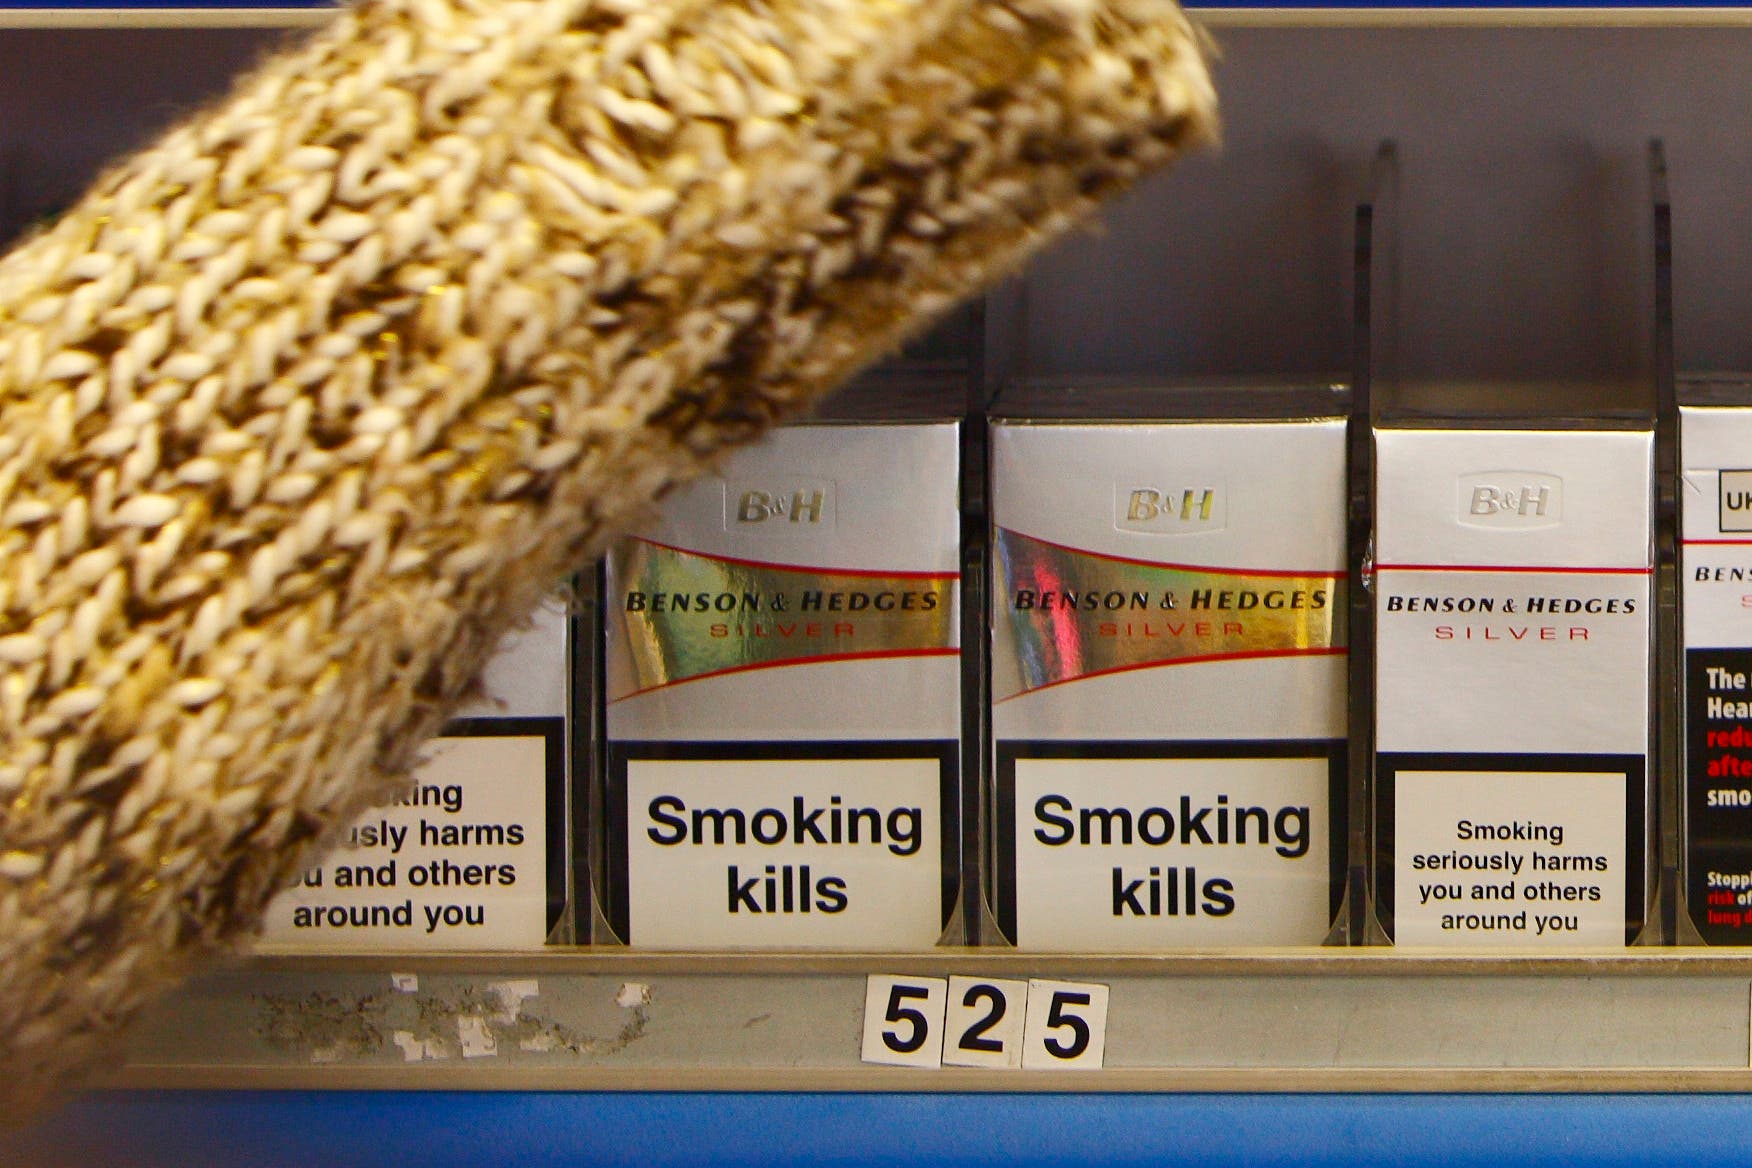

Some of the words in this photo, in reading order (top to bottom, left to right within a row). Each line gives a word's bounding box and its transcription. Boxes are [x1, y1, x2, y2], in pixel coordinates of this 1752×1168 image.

[1470, 486, 1550, 517] B&H
[626, 591, 760, 613] BENSON
[771, 592, 787, 612] &
[801, 591, 938, 612] HEDGES
[1015, 589, 1149, 611] BENSON
[1161, 590, 1176, 610] &
[1190, 589, 1327, 610] HEDGES
[1387, 596, 1495, 613] BENSON
[1502, 598, 1518, 614] &
[1526, 597, 1637, 615] HEDGES
[710, 623, 855, 638] SILVER
[1099, 622, 1244, 637] SILVER
[1435, 627, 1590, 642] SILVER
[1706, 667, 1746, 689] The
[646, 795, 923, 856] Smoking
[1033, 794, 1311, 857] Smoking
[1457, 820, 1564, 845] Smoking
[1412, 851, 1524, 876] seriously
[1531, 851, 1608, 872] harms
[727, 865, 848, 915] kills
[1112, 866, 1236, 917] kills
[1419, 882, 1464, 904] you
[1471, 881, 1516, 901] and
[1523, 881, 1601, 901] others
[1441, 910, 1527, 932] around
[1536, 913, 1579, 935] you
[881, 985, 1091, 1059] 525
